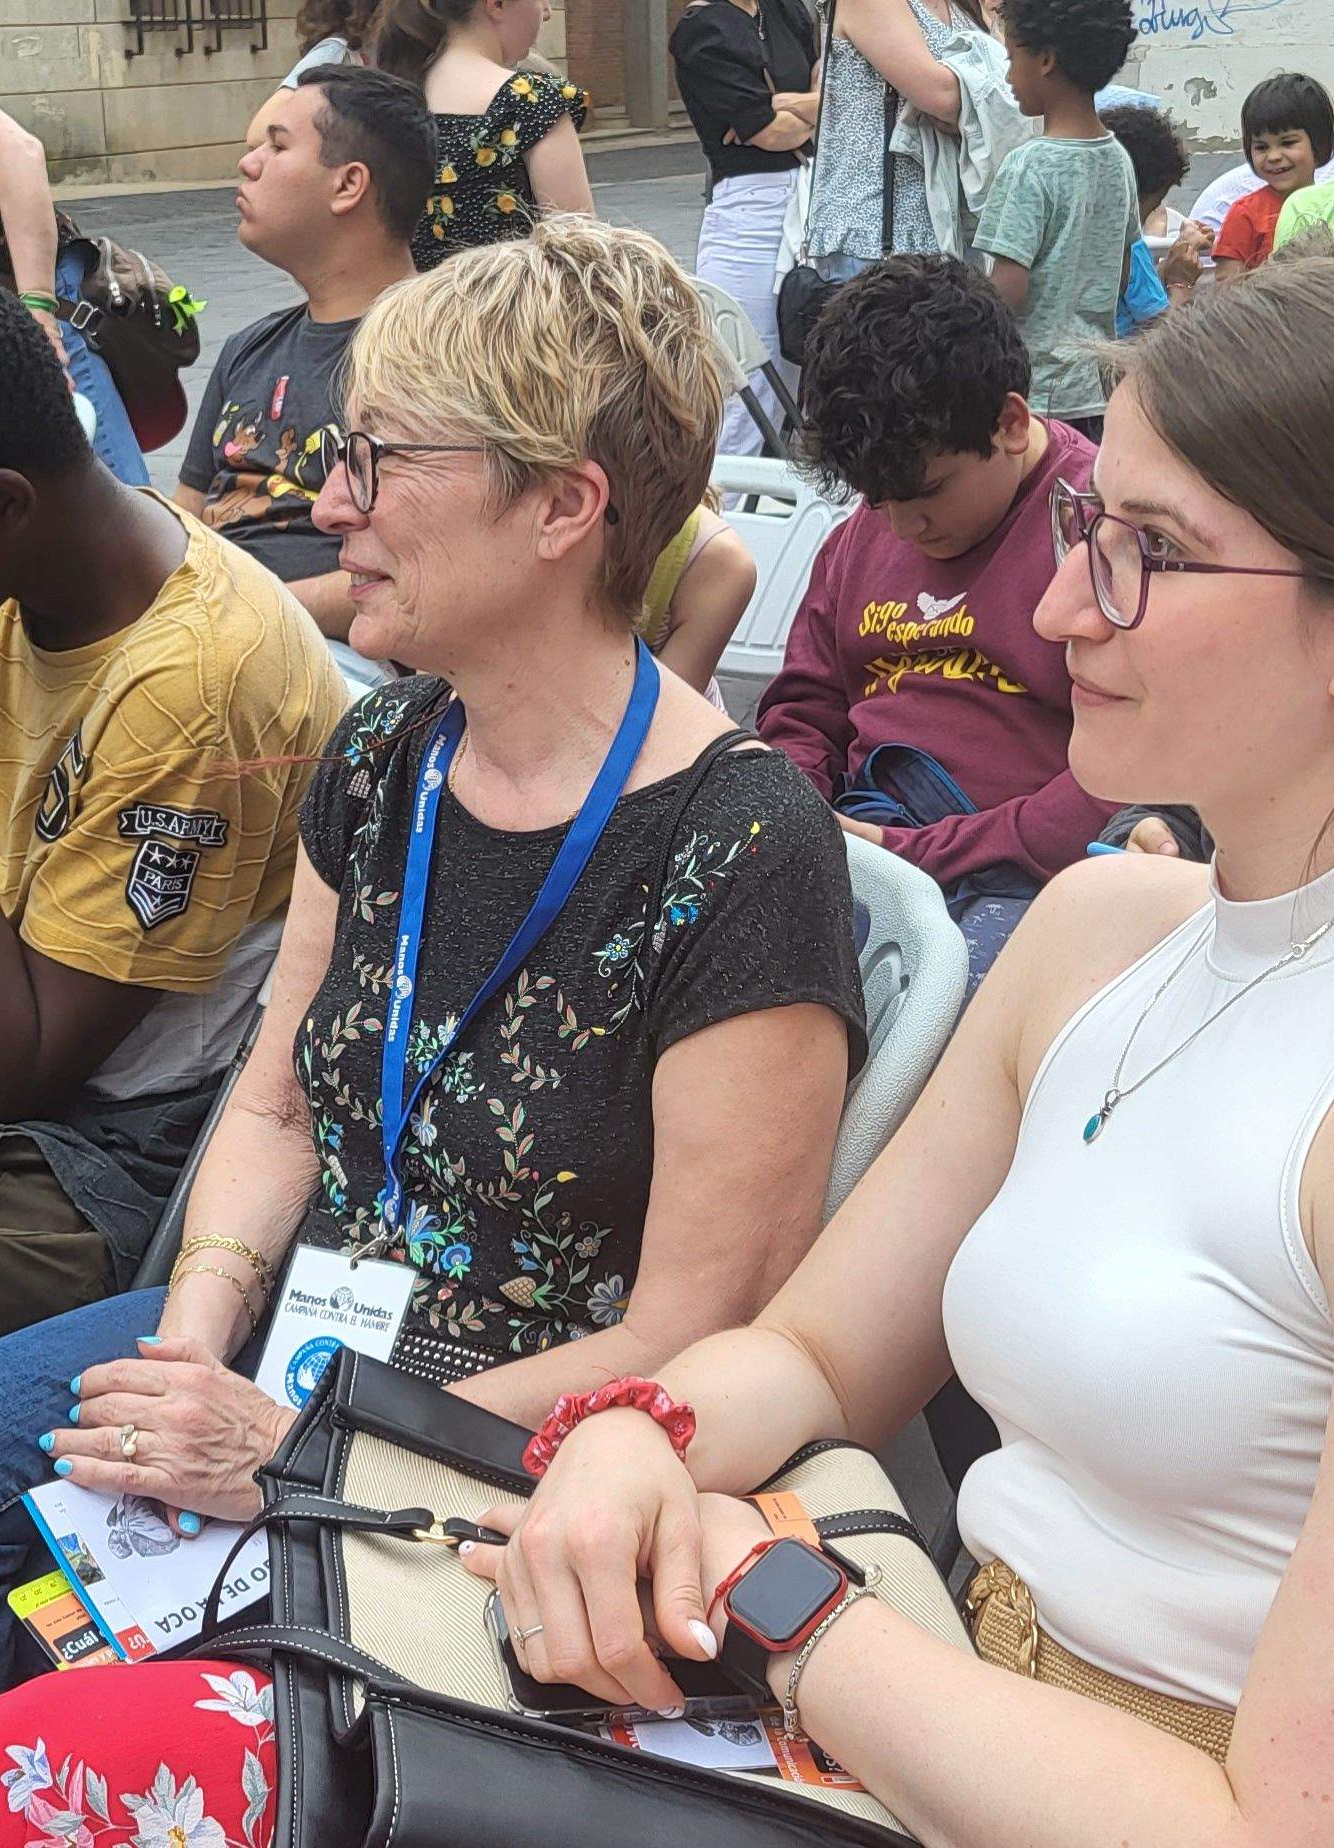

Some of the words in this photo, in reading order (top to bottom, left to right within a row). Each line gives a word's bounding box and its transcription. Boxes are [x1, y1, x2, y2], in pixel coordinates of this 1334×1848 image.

[859, 600, 908, 637] Sigo
[886, 604, 974, 650] esperando
[427, 734, 447, 769] Manos
[416, 791, 429, 833] Unidas
[143, 871, 184, 891] PARIS
[397, 934, 410, 976] Manos
[388, 999, 402, 1043] Unidas
[289, 1289, 328, 1307] Manos
[354, 1303, 394, 1320] Unidas
[319, 1309, 349, 1325] CONTRA
[350, 1315, 358, 1325] EL
[223, 1576, 251, 1599] DE
[154, 1607, 198, 1634] OCA
[63, 1630, 99, 1660] ¿Cuál
